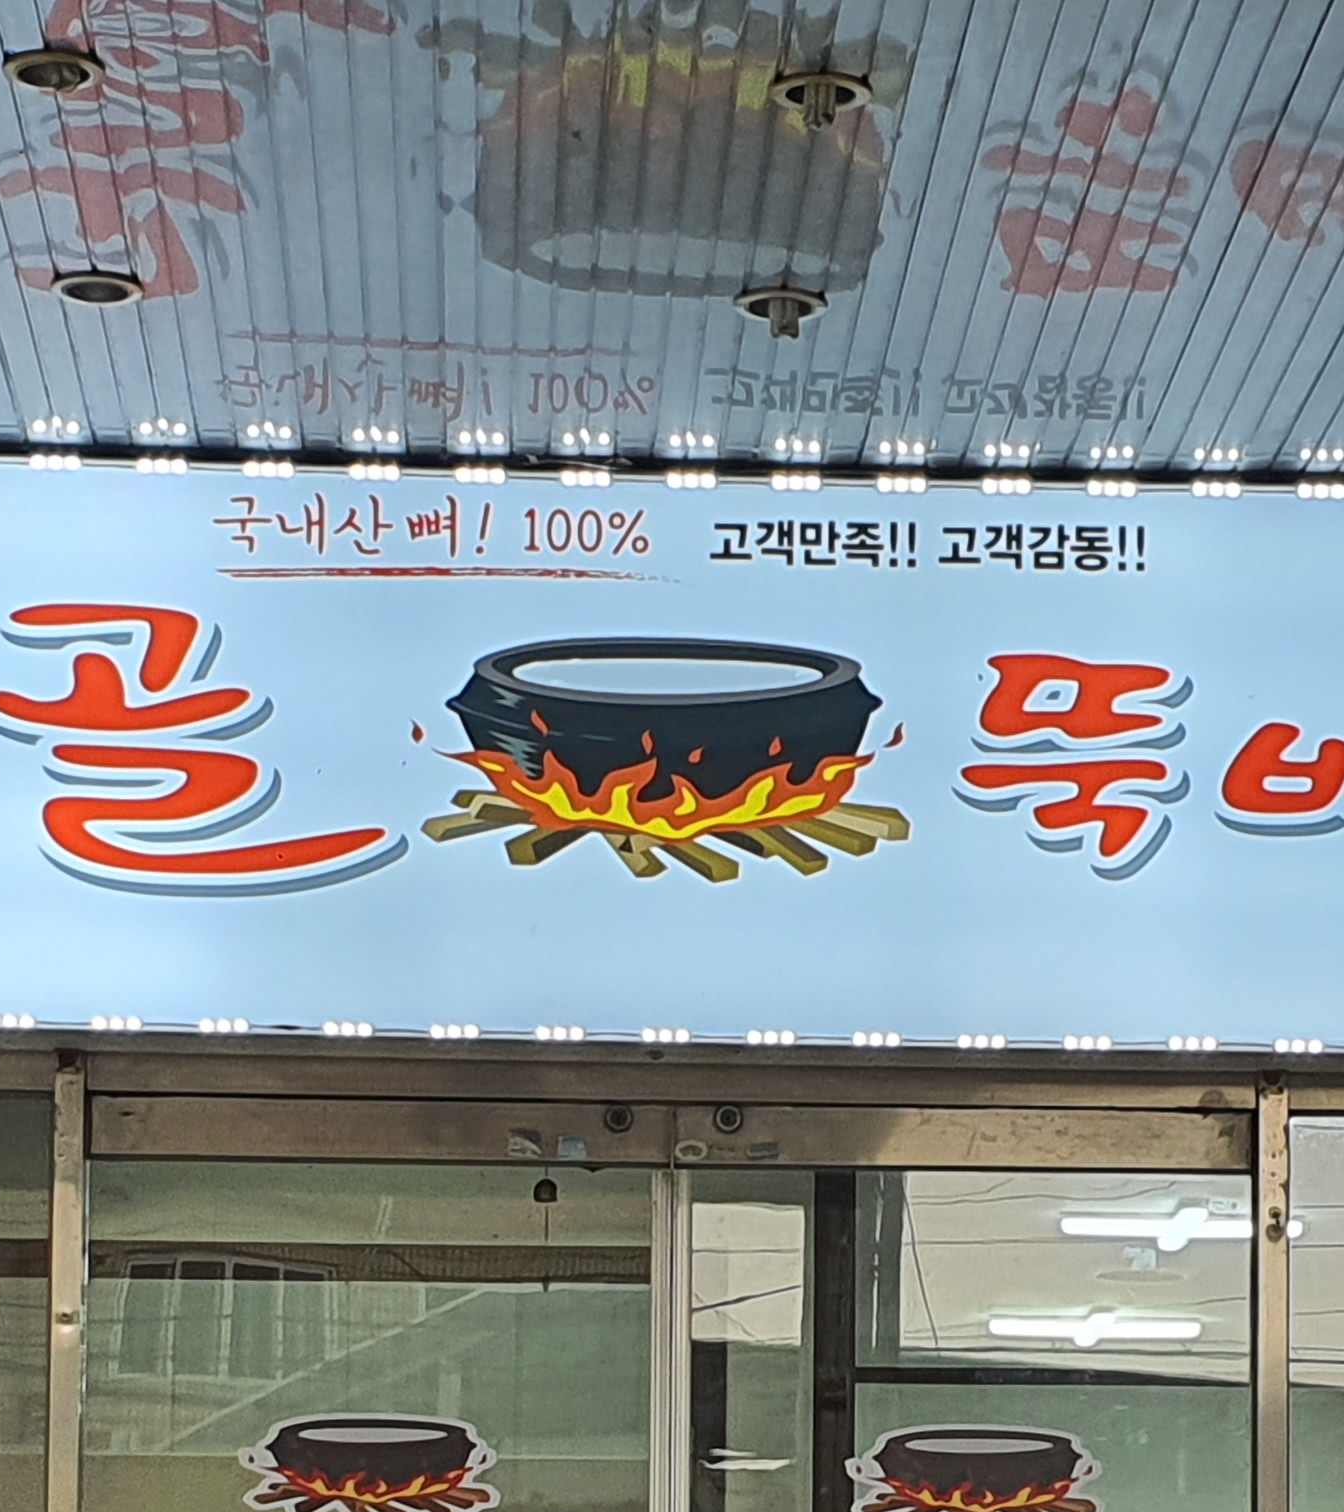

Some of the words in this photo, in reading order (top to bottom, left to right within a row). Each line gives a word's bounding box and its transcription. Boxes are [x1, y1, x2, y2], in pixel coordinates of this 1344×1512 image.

[212, 491, 394, 556] 국내산
[405, 494, 491, 558] 뼈!
[523, 507, 650, 556] 100%
[709, 519, 917, 568] 고객만족!!
[937, 523, 1145, 572] 고객감동!!
